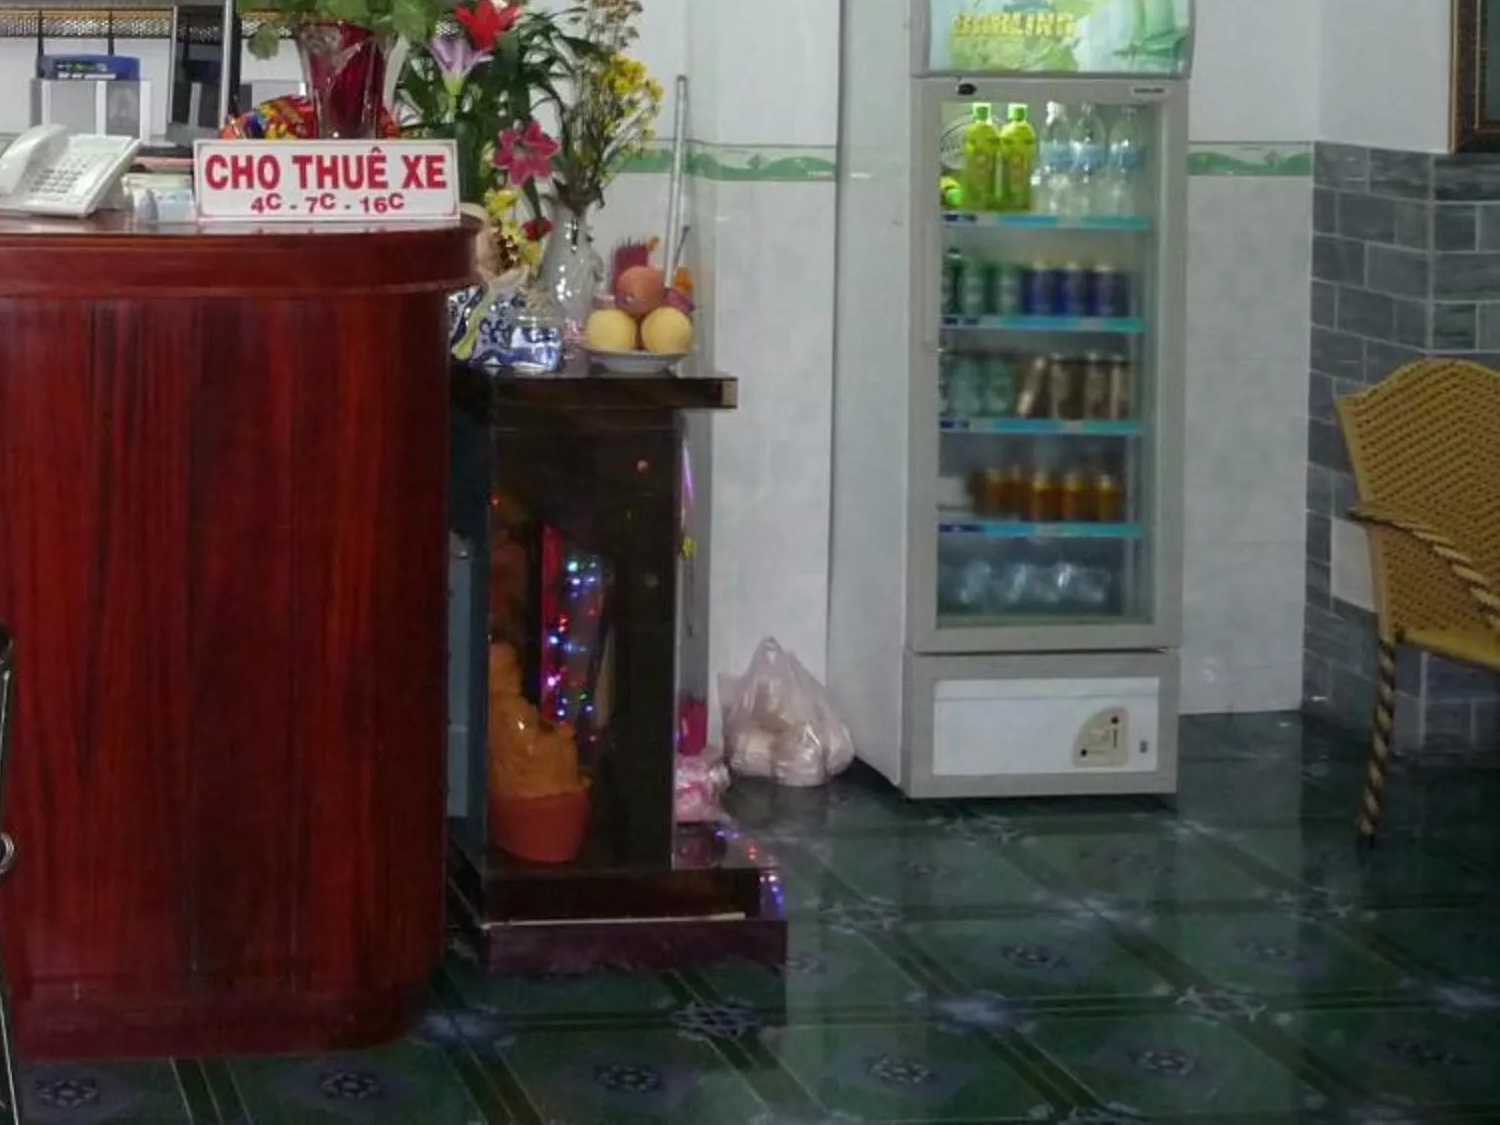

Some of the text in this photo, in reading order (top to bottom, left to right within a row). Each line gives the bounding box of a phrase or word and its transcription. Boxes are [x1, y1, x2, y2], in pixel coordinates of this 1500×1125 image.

[204, 146, 447, 190] CHO THUÊ XE
